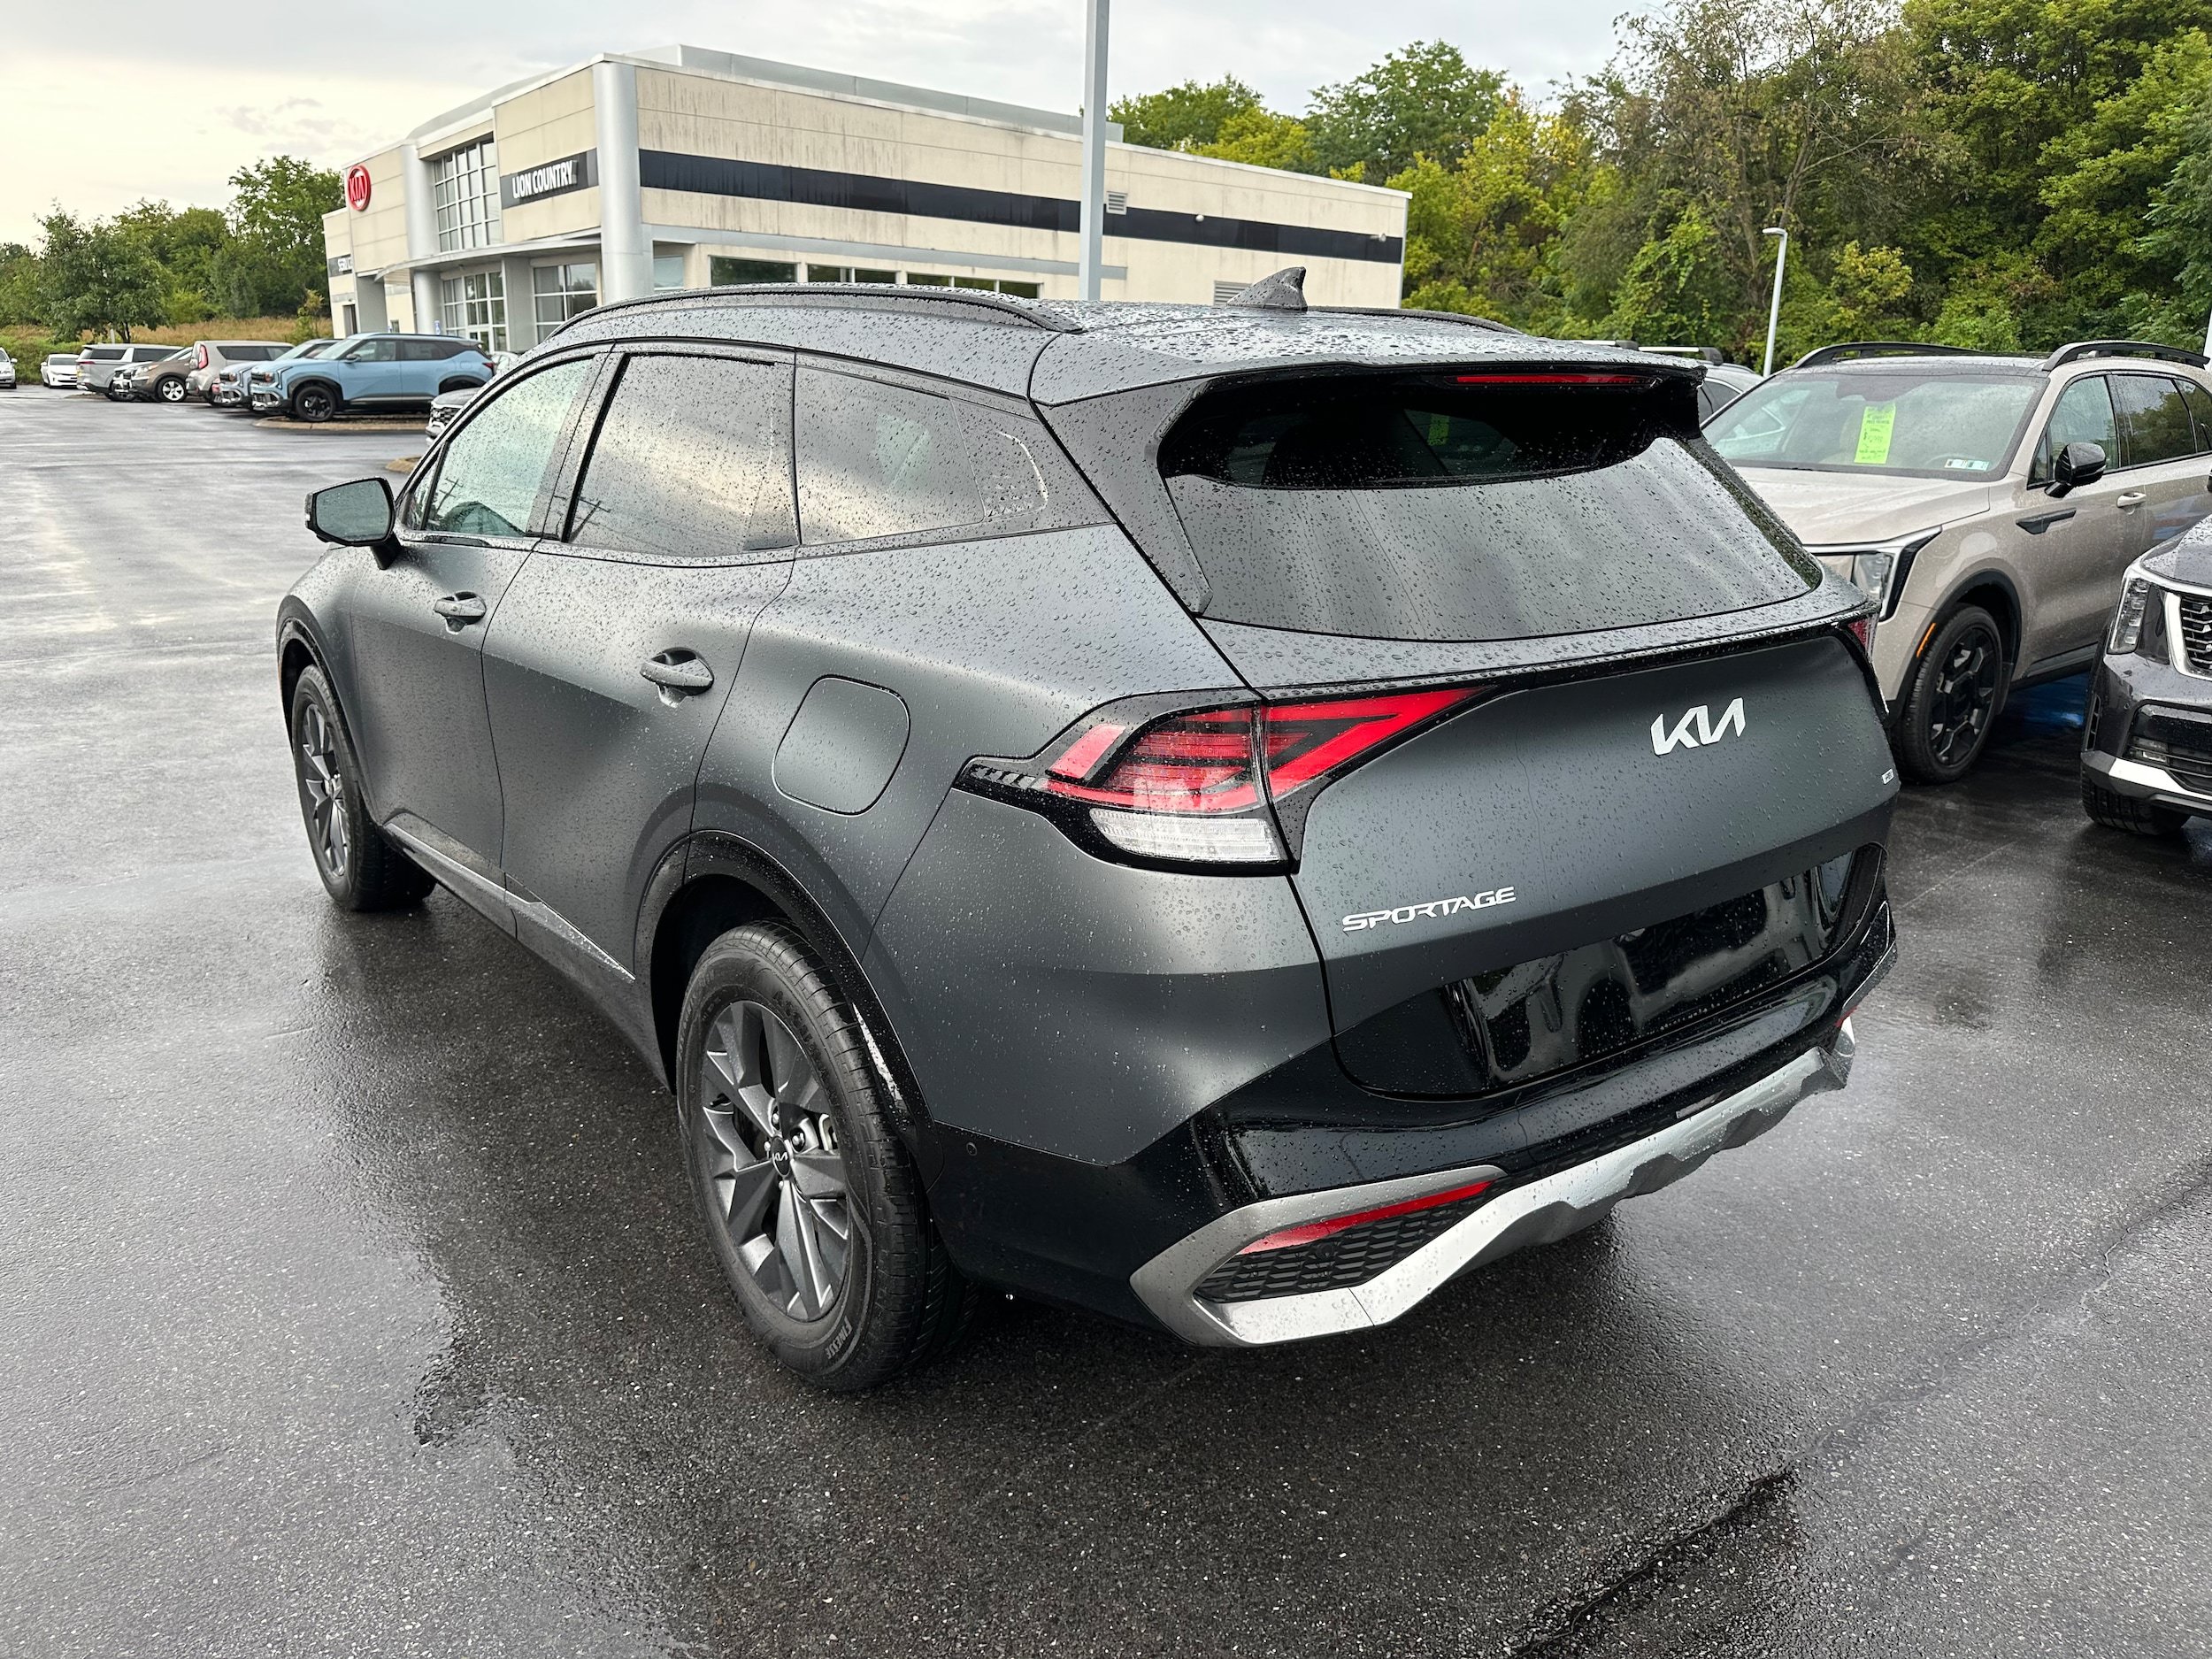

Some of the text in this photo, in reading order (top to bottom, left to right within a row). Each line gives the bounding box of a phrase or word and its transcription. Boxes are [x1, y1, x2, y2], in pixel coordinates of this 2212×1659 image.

[512, 160, 572, 199] LION COUNTRY
[1650, 697, 1746, 756] KIA
[1341, 886, 1517, 932] SPORTAGE
[825, 1315, 853, 1360] FINESSE
